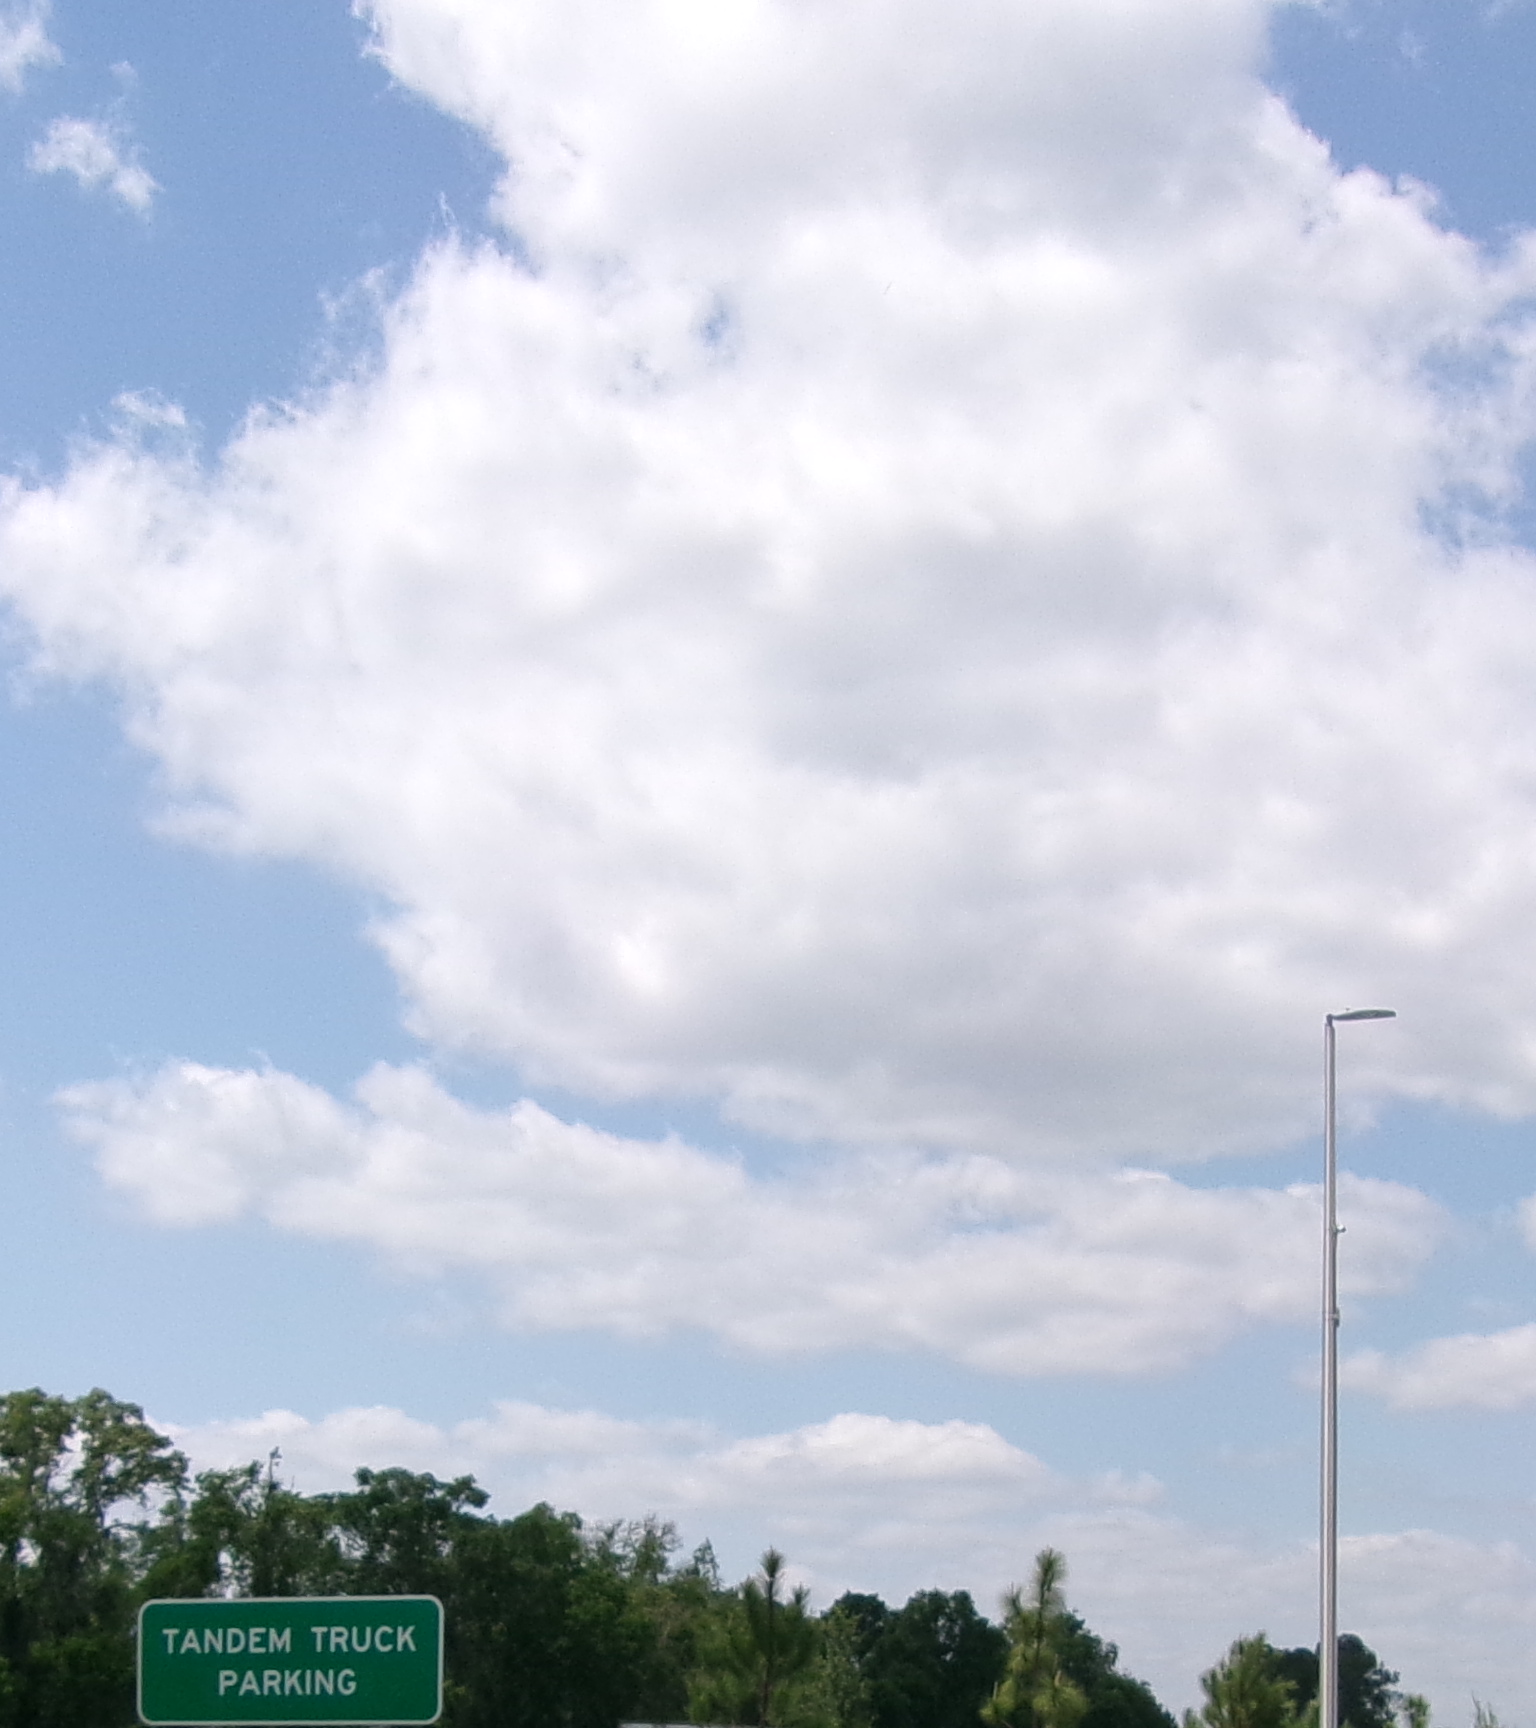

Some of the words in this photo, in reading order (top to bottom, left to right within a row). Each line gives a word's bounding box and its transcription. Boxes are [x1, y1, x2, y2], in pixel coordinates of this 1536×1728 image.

[162, 1627, 291, 1654] TANDEM
[311, 1625, 416, 1652] TRUCK
[219, 1669, 357, 1696] PARKING
